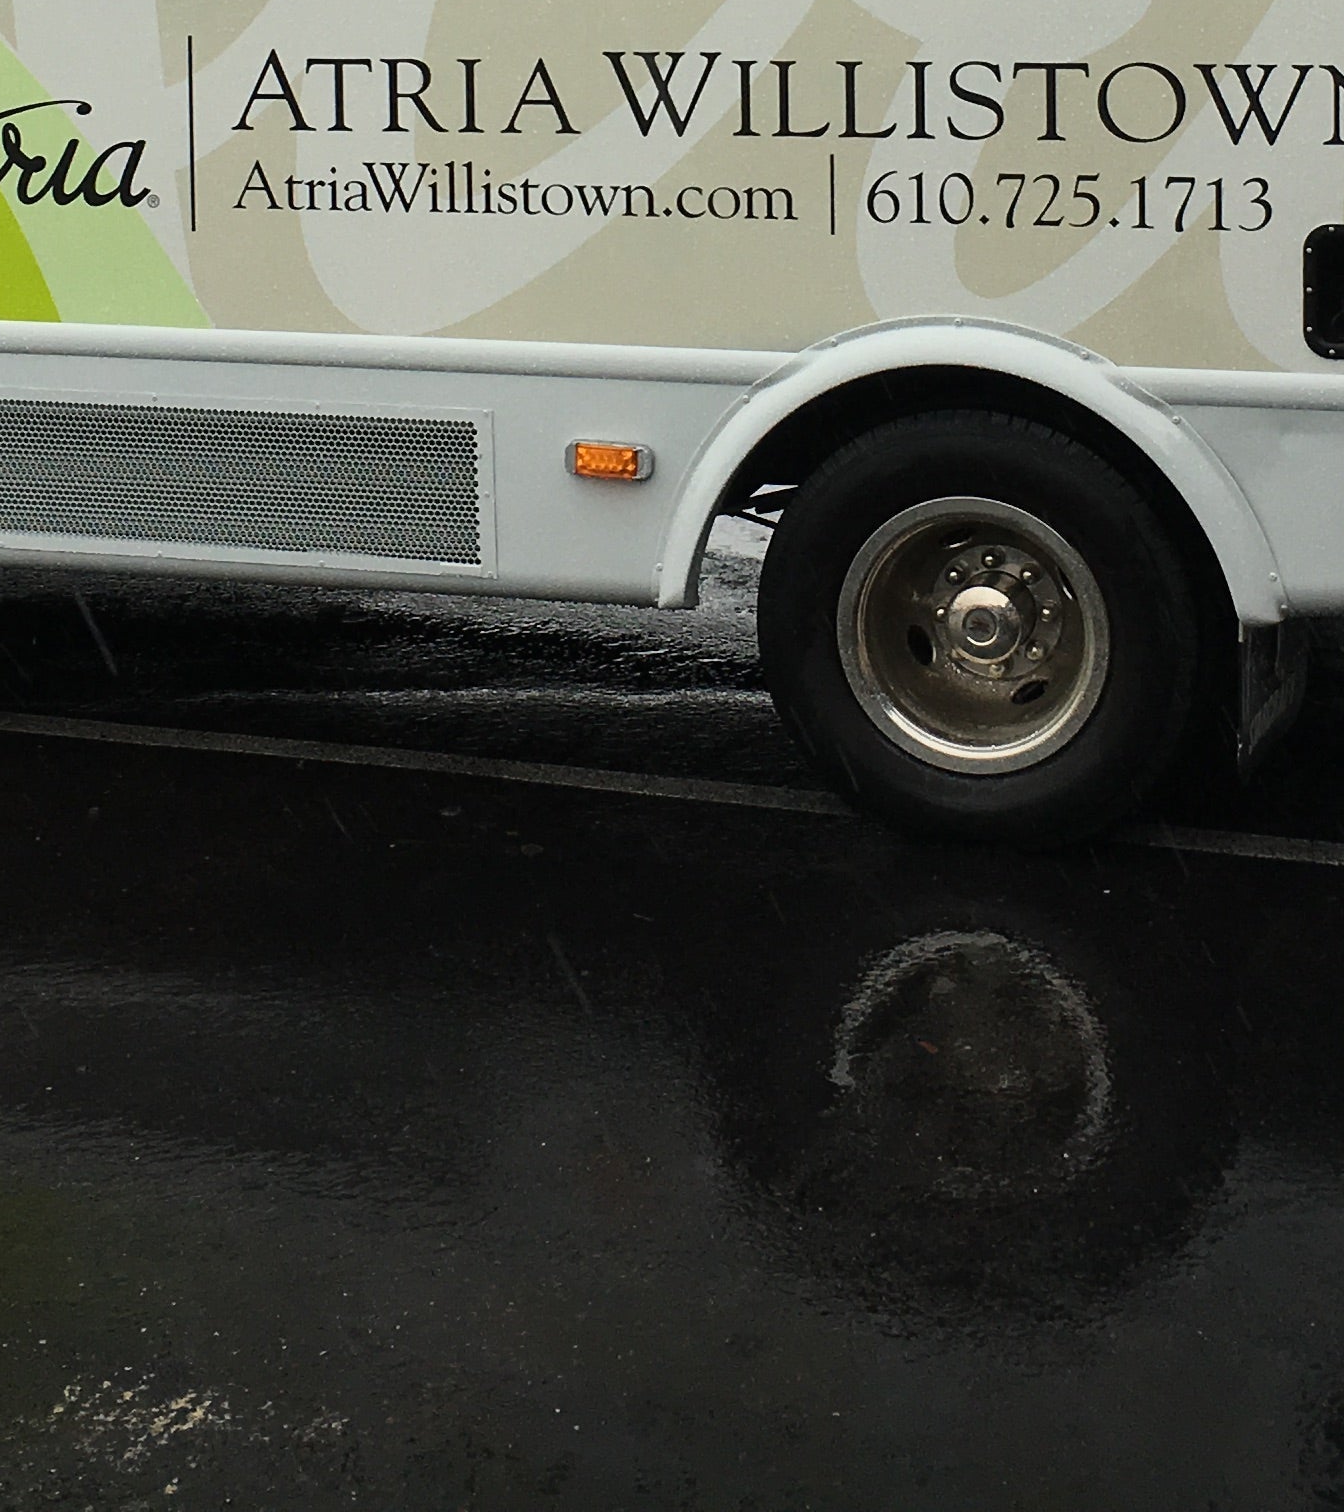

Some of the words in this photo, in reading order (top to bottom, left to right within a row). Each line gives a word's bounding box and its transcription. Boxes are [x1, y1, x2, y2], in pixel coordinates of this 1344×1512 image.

[231, 48, 582, 135] ATRIA
[233, 159, 799, 222] AtriaWillistown.com
[866, 170, 1275, 233] 610.725.1713
